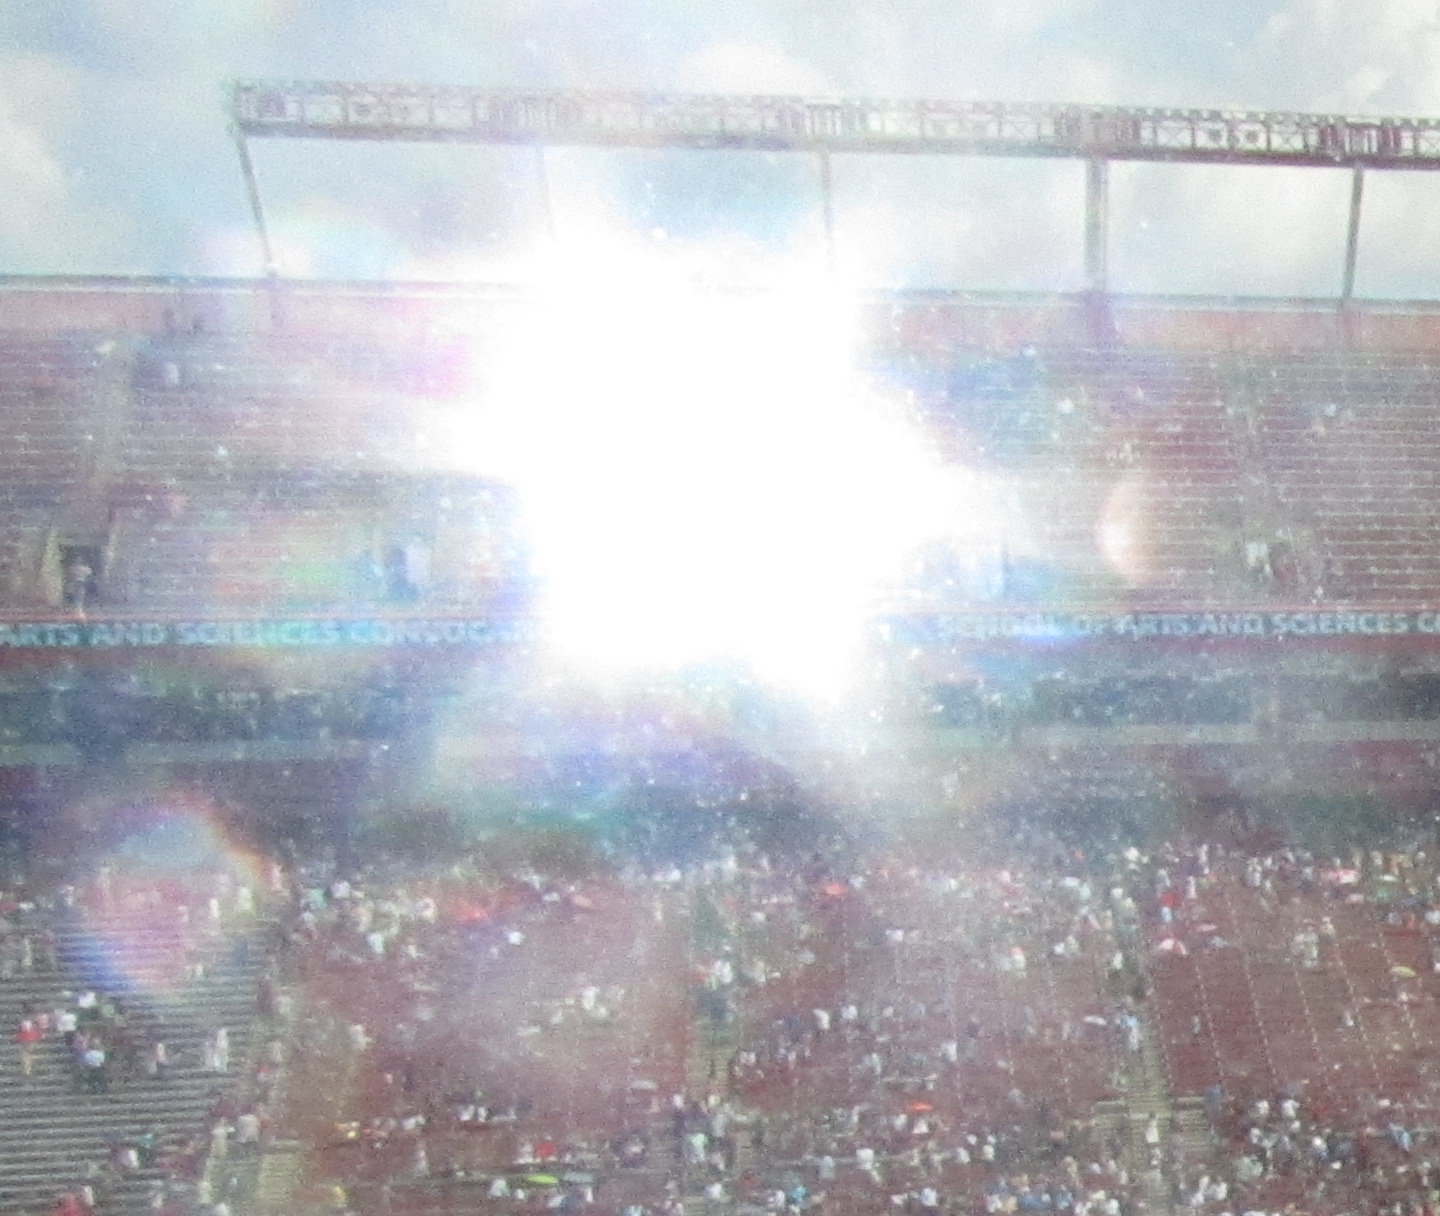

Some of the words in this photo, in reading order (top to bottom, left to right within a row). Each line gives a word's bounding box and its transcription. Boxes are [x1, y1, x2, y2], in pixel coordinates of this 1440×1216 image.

[90, 622, 167, 646] AND
[1198, 612, 1265, 635] AND
[1271, 611, 1409, 635] SCIENCES
